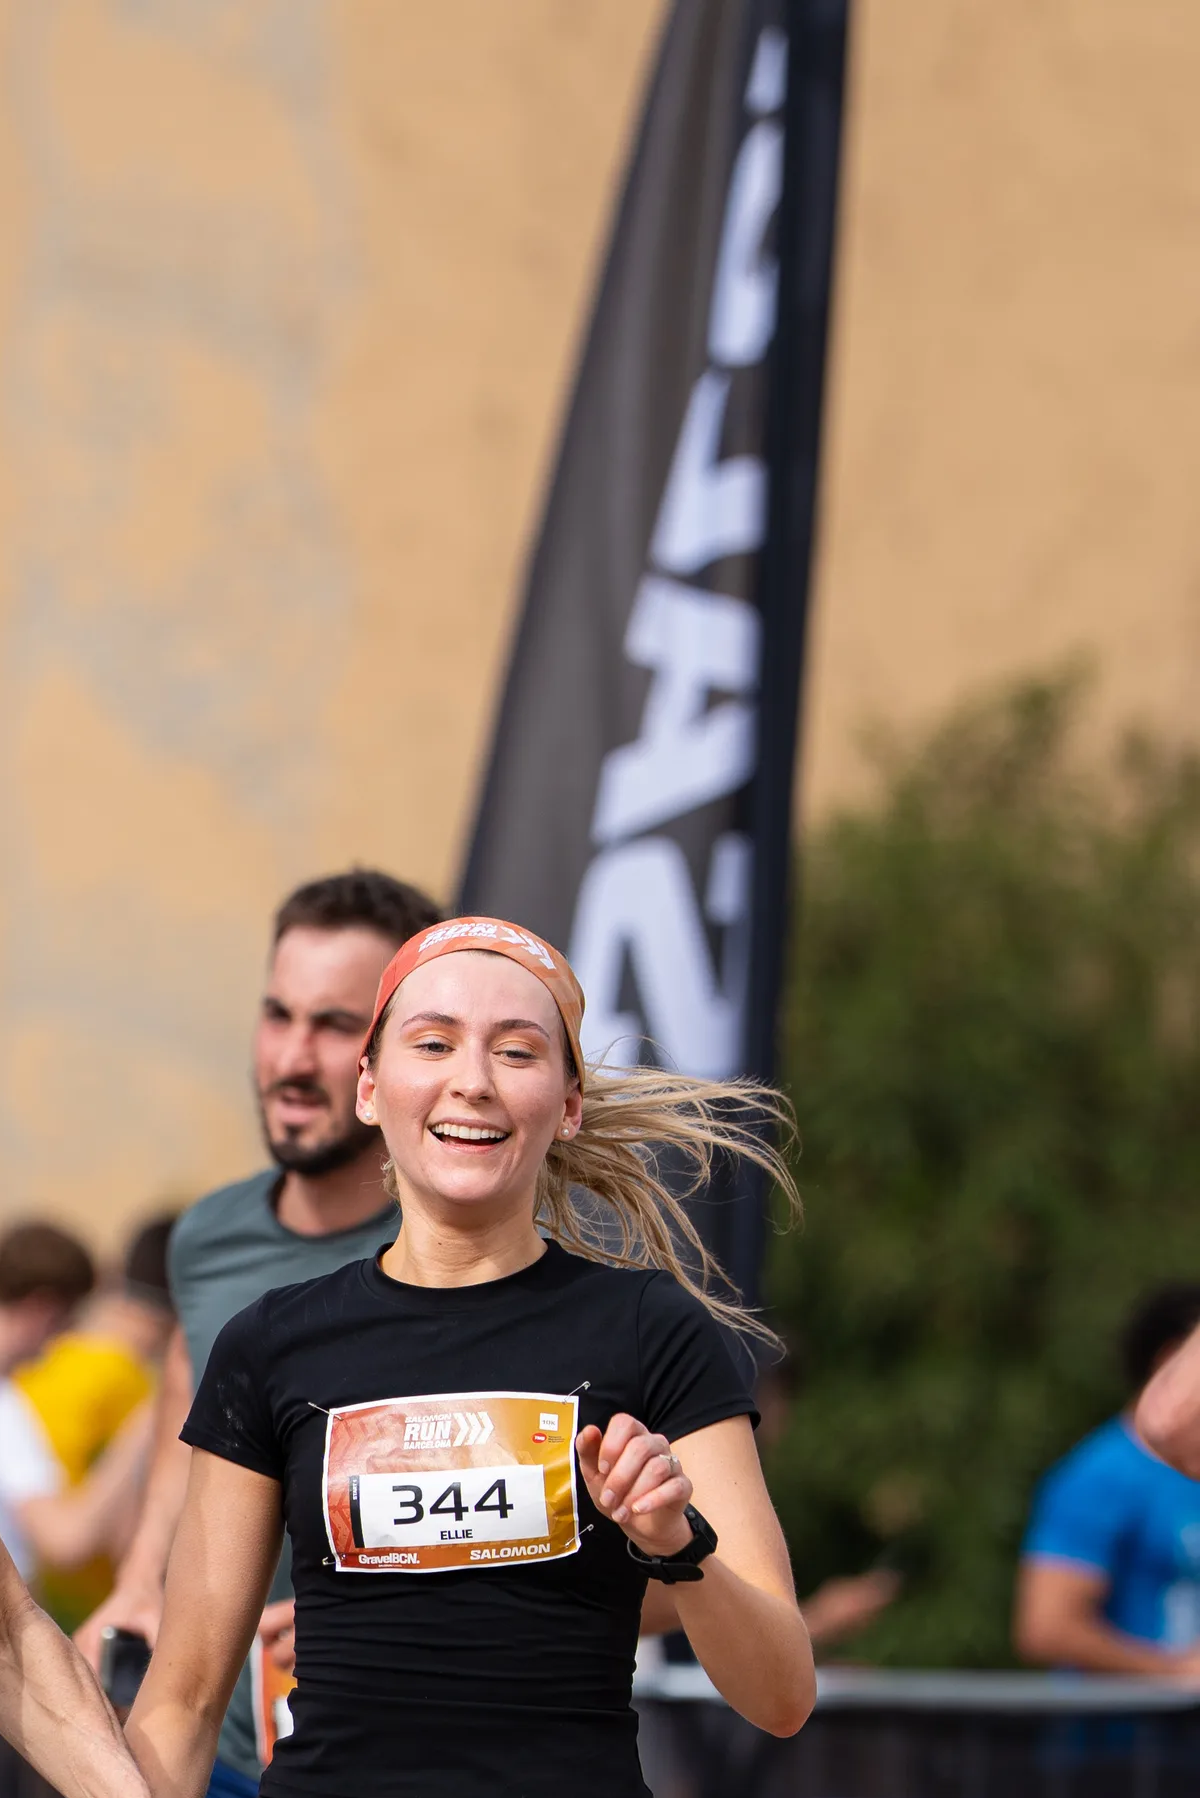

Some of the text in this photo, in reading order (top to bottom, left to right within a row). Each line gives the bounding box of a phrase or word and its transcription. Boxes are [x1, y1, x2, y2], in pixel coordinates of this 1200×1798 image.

[404, 1420, 452, 1441] RUN
[392, 1478, 514, 1525] 344
[440, 1529, 473, 1540] ELLIE
[470, 1543, 551, 1561] SALOMON
